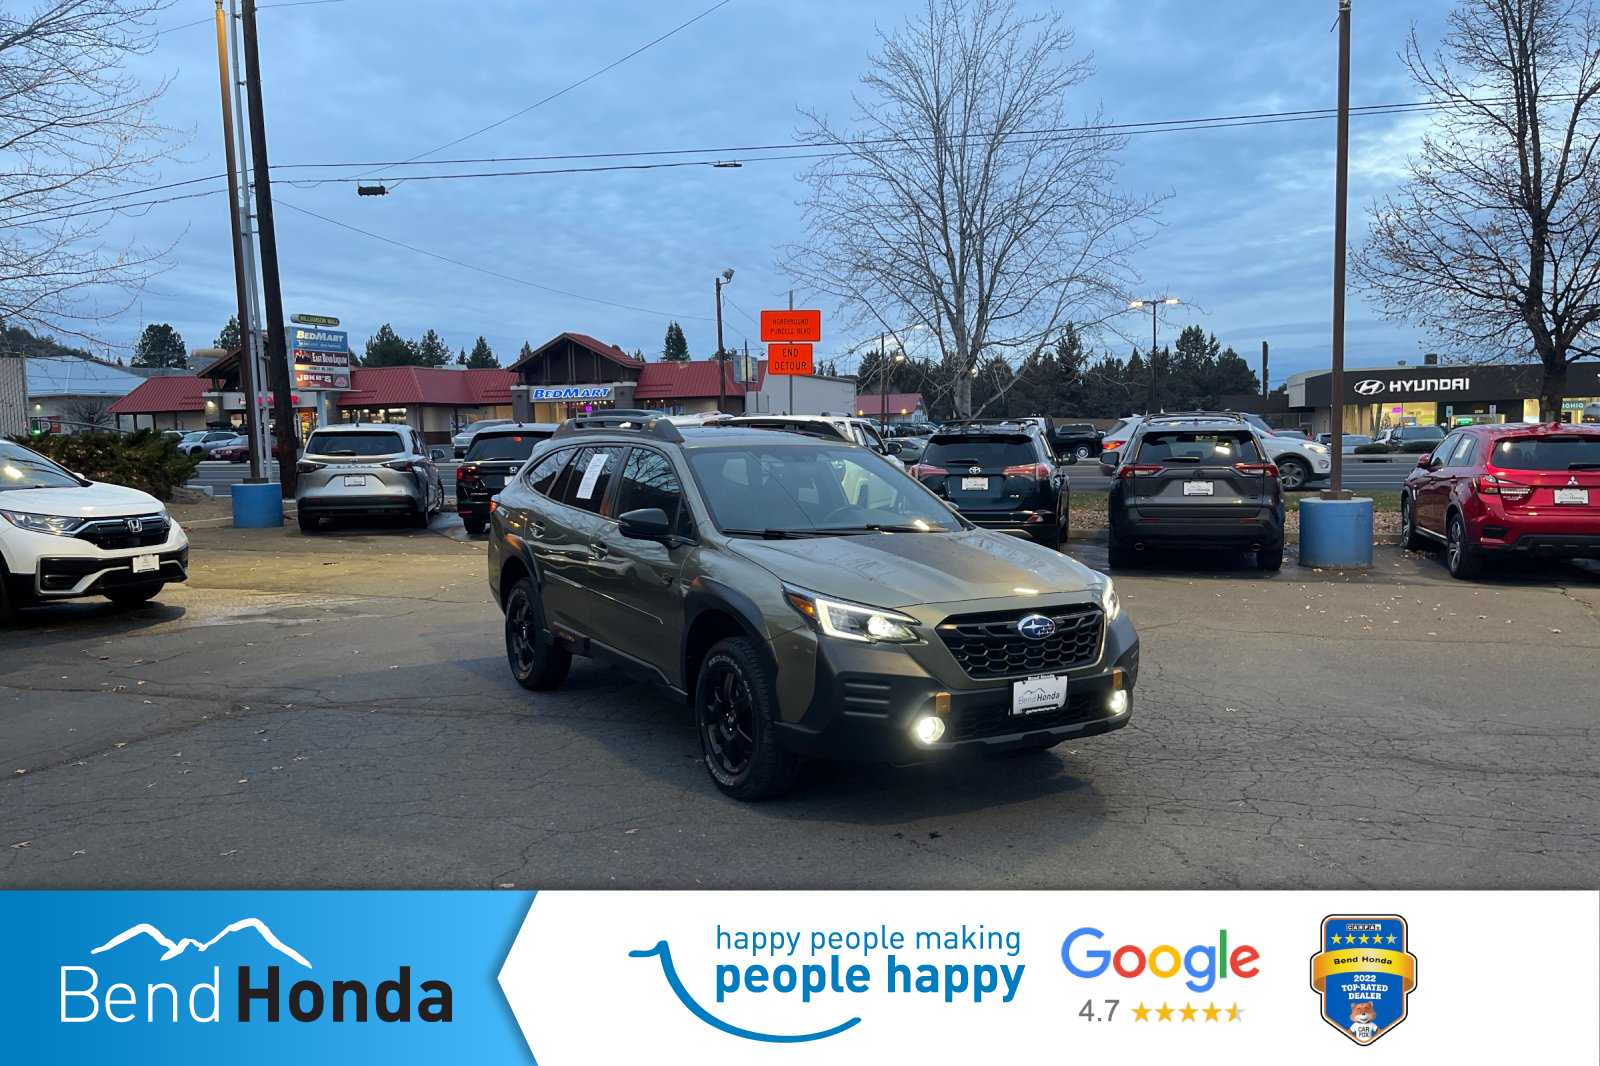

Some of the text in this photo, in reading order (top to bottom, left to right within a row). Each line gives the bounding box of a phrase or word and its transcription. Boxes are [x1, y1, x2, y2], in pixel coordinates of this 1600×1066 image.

[782, 348, 799, 358] END
[774, 361, 807, 370] DETOUR
[1389, 377, 1470, 393] HYUNDAI
[1037, 691, 1060, 702] Honda
